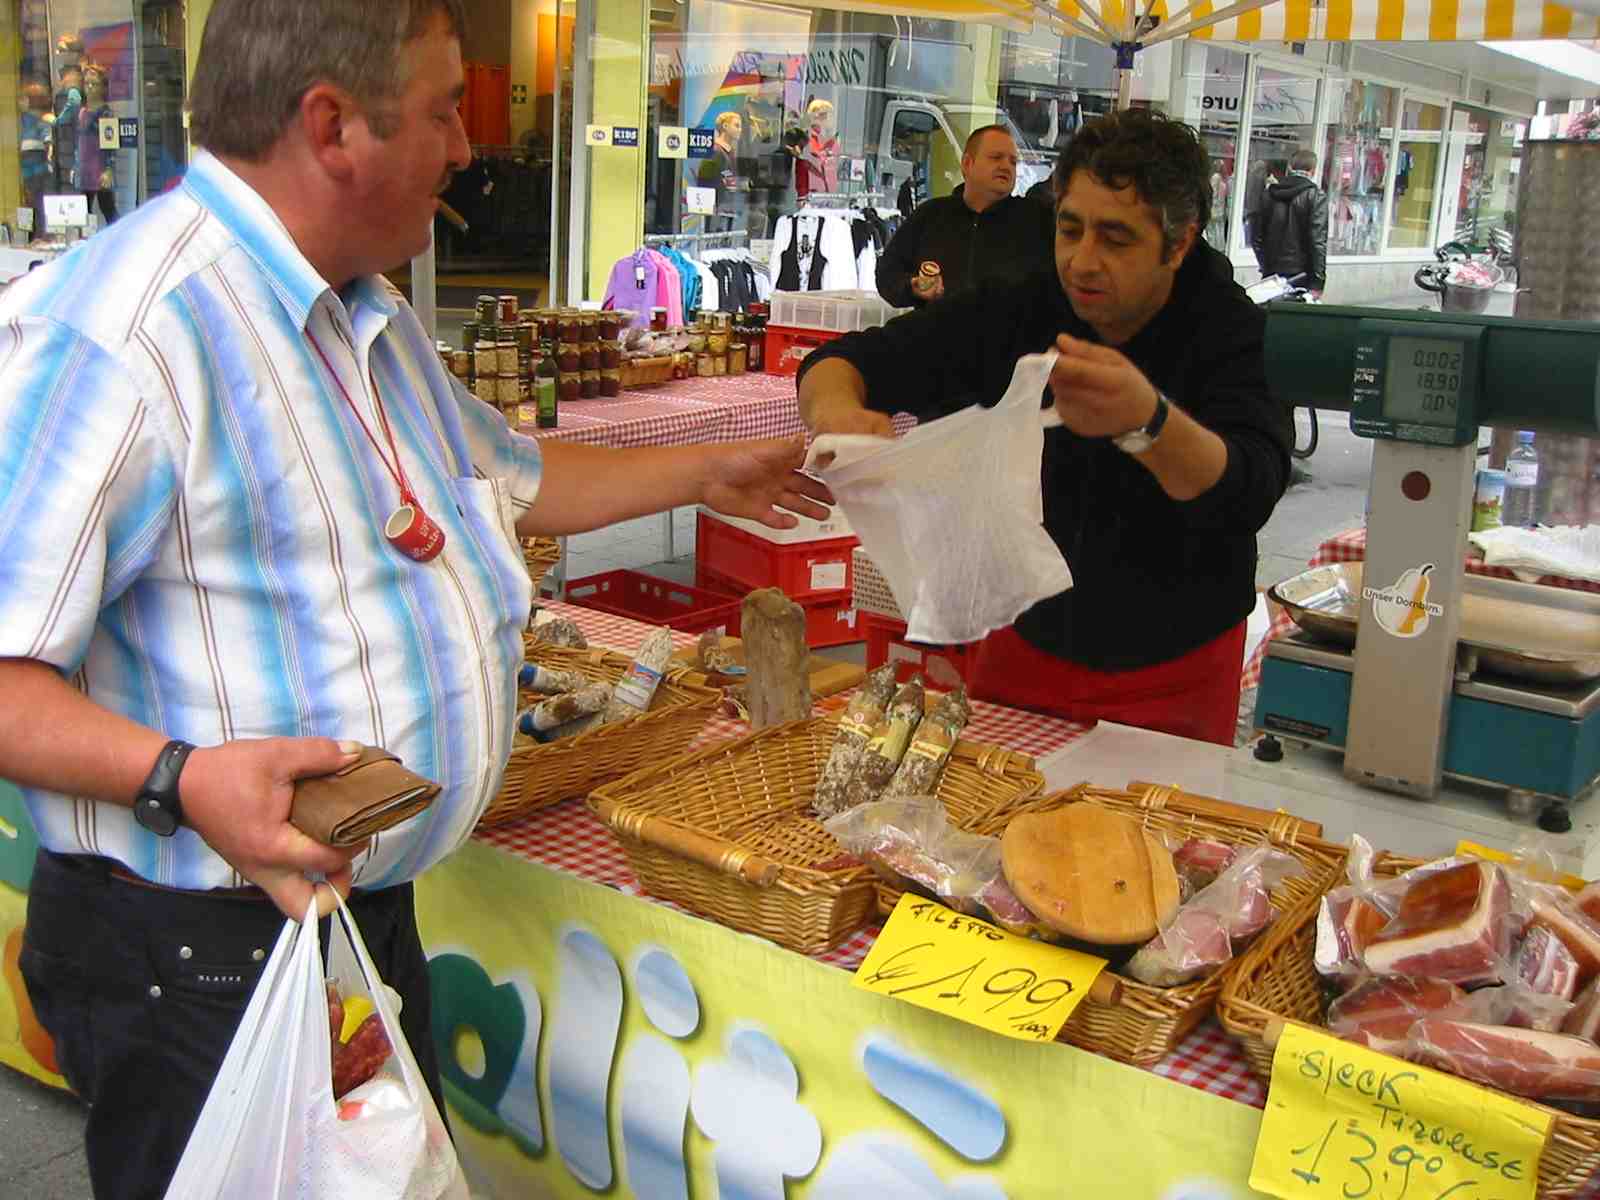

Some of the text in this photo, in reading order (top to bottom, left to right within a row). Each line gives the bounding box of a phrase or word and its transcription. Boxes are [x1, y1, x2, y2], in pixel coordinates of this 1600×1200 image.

[615, 129, 637, 140] KIDS
[689, 135, 713, 148] KIDS
[1365, 588, 1394, 603] Unser
